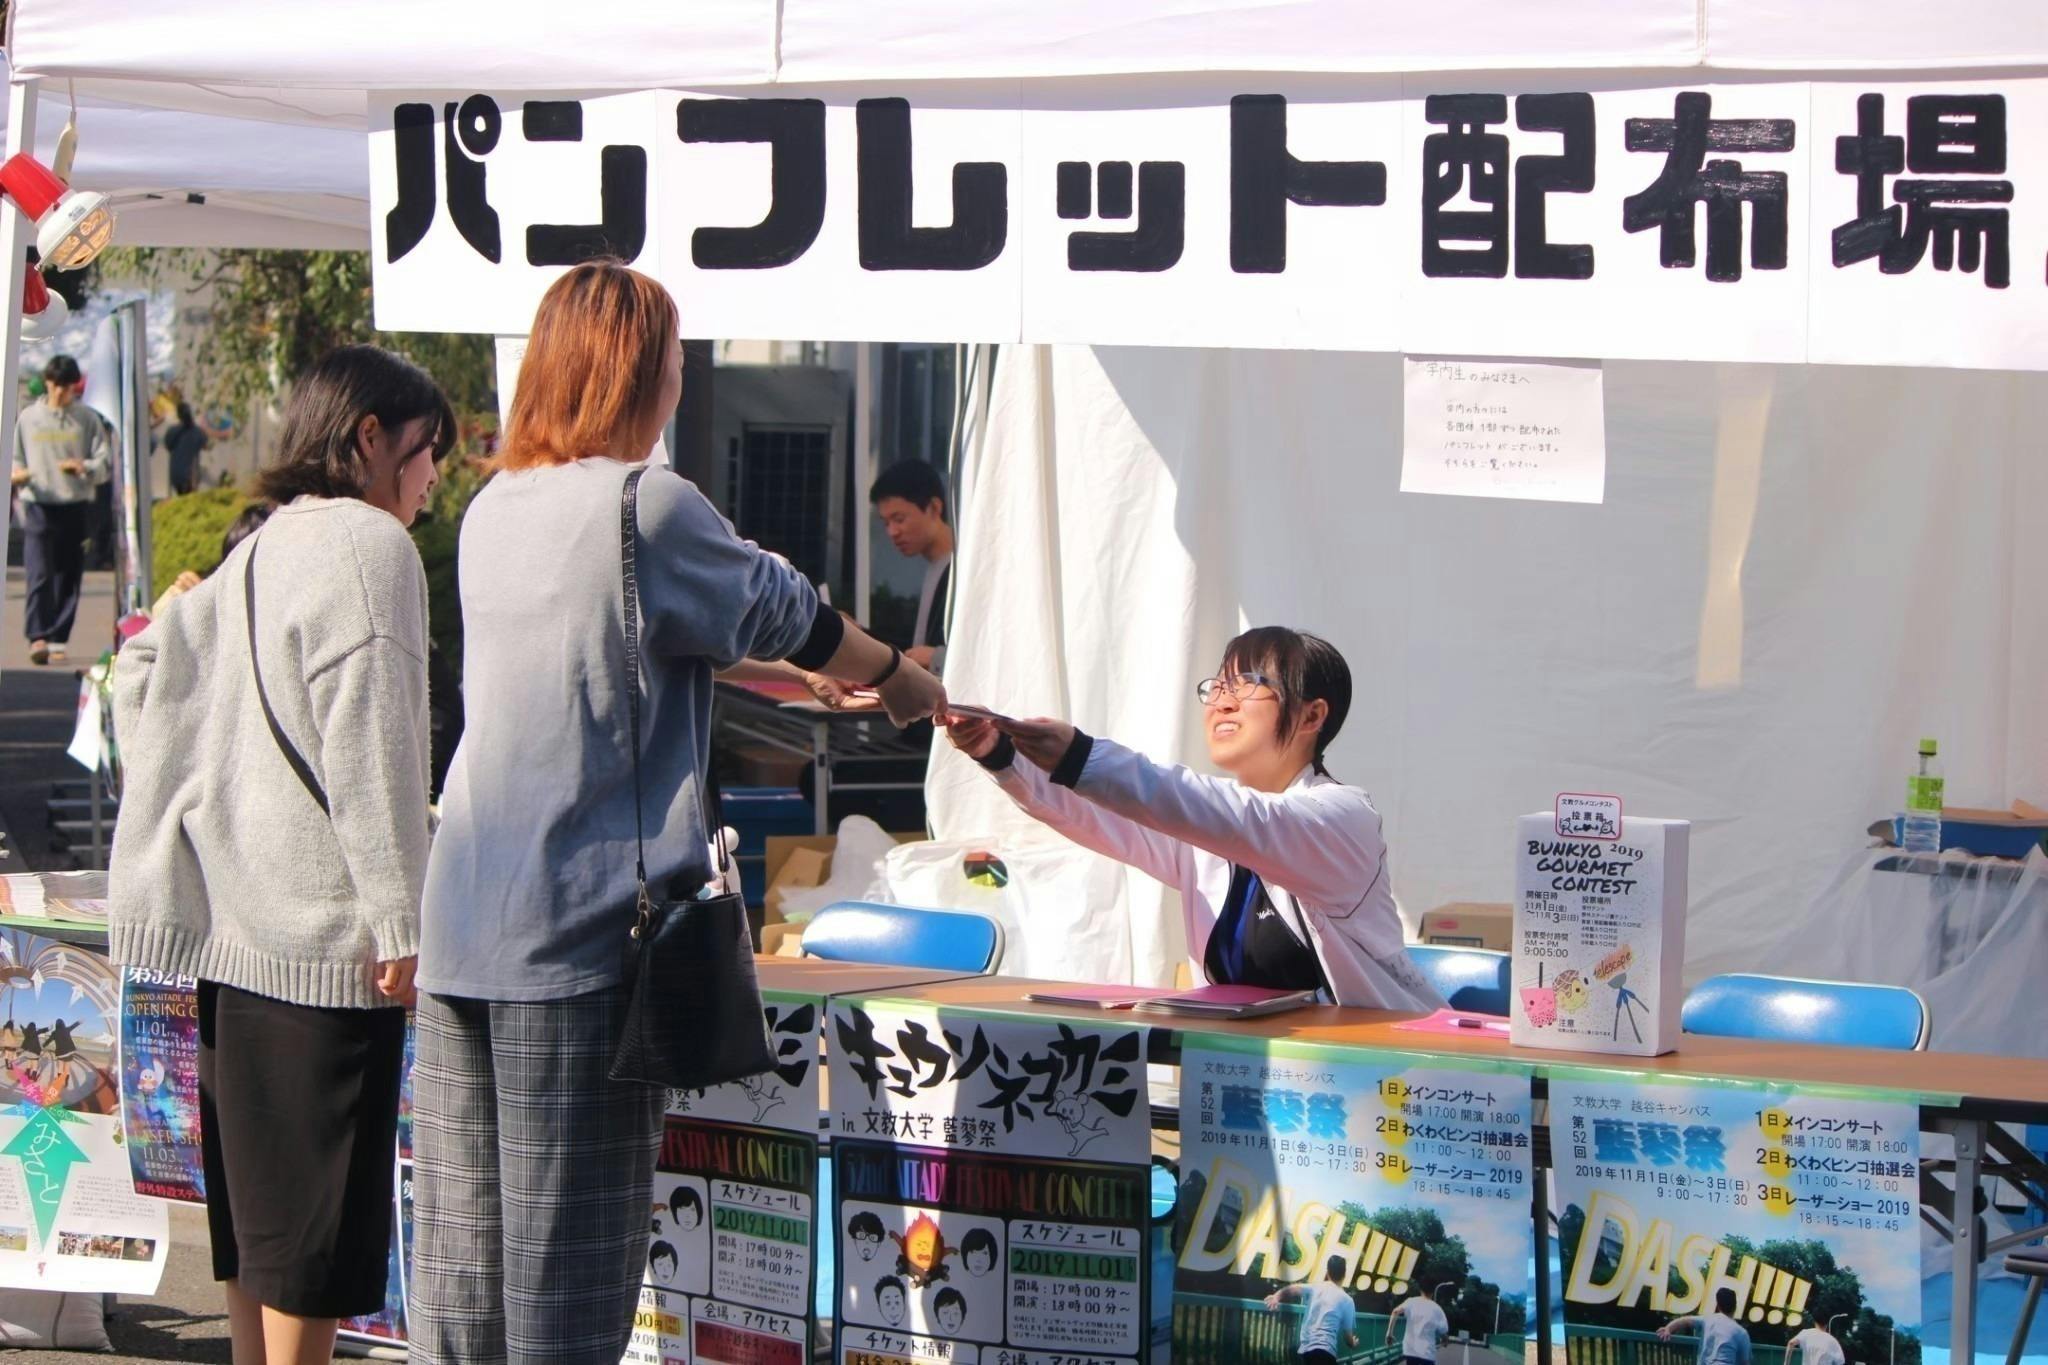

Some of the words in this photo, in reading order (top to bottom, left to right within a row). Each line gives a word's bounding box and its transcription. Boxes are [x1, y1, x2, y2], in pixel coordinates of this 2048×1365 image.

[1527, 840, 1602, 859] BUNKYO
[1610, 843, 1643, 862] 2019
[1536, 857, 1633, 877] GOURMET
[1526, 890, 1558, 900] 開催日時
[1552, 876, 1637, 895] CONTEST
[1524, 931, 1569, 941] 投票受付時間
[1524, 947, 1546, 957] 9:00
[1547, 948, 1569, 958] 5:00
[125, 1003, 187, 1017] OPENING
[1204, 1062, 1249, 1076] 文教大学
[1259, 1066, 1336, 1085] 越谷キャンパス
[1201, 1082, 1214, 1125] 第52回
[1376, 1080, 1398, 1095] 1日
[1402, 1085, 1496, 1106] メインコンサート
[1400, 1103, 1422, 1117] 開場
[1428, 1106, 1456, 1119] 17:00
[1461, 1109, 1483, 1122] 開演
[1490, 1112, 1520, 1124] 18:00
[1573, 1096, 1621, 1111] 文教大学
[1631, 1100, 1712, 1117] 越谷キャンパス
[842, 1112, 855, 1133] in
[862, 1107, 933, 1140] 文教大学
[1376, 1116, 1398, 1132] 2日
[1402, 1123, 1529, 1147] わくわくビンゴ抽選会
[1755, 1110, 1778, 1127] 1日
[1783, 1116, 1883, 1135] メインコンサート
[1572, 1116, 1587, 1159] 第52回
[1781, 1134, 1806, 1147] 開場
[1811, 1136, 1841, 1149] 17:00
[1846, 1139, 1871, 1152] 開演
[1877, 1141, 1908, 1153] 18:00
[24, 1122, 62, 1204] みさと
[143, 1147, 176, 1163] 11.03
[1756, 1148, 1780, 1164] 2日
[1785, 1155, 1915, 1178] わくわくビンゴ抽選会
[1375, 1152, 1398, 1168] 3日
[1402, 1160, 1485, 1180] レーザーショー
[1489, 1168, 1522, 1184] 2019
[722, 1184, 800, 1211] スケジュール
[956, 1165, 1038, 1213] FESTIVAL
[1045, 1171, 1135, 1219] CONCERT
[1758, 1184, 1781, 1200] 3日
[1786, 1192, 1872, 1211] レーザーショー
[1878, 1200, 1910, 1215] 2019
[1022, 1223, 1125, 1247] スケジュール
[1013, 1249, 1124, 1280] 2019.11.01
[866, 1331, 951, 1360] チケット情報
